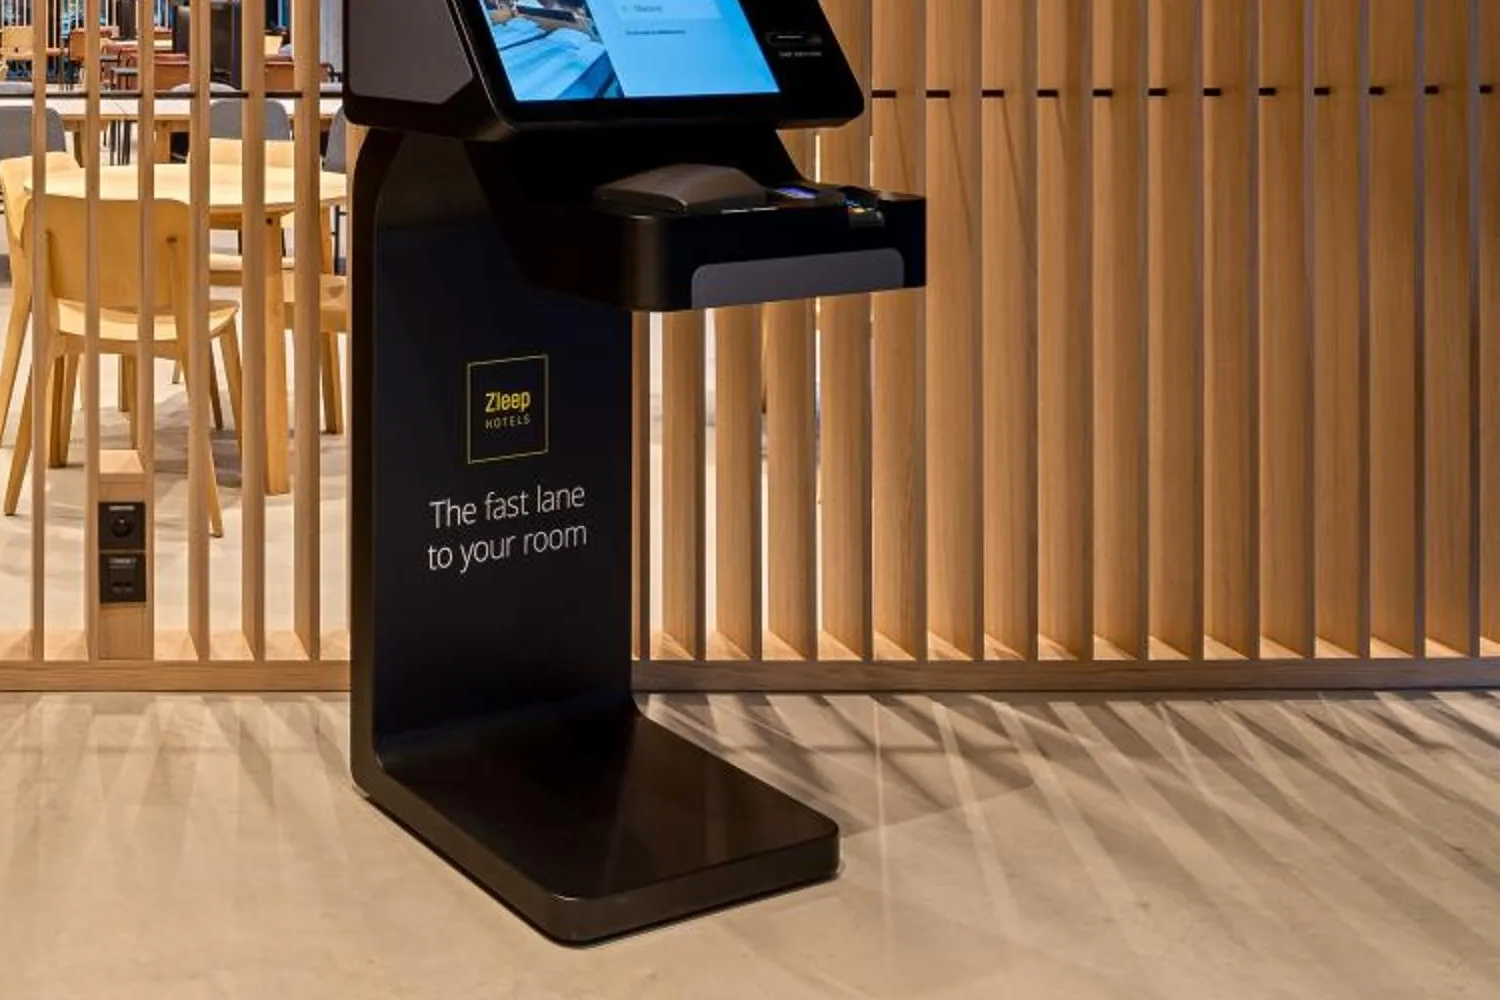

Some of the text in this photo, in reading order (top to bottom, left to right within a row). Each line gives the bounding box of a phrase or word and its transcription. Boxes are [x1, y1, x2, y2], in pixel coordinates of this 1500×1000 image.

[485, 391, 531, 412] Zleep
[485, 414, 531, 429] HOTELS
[429, 485, 585, 528] The fast lane
[428, 525, 587, 573] to your room
